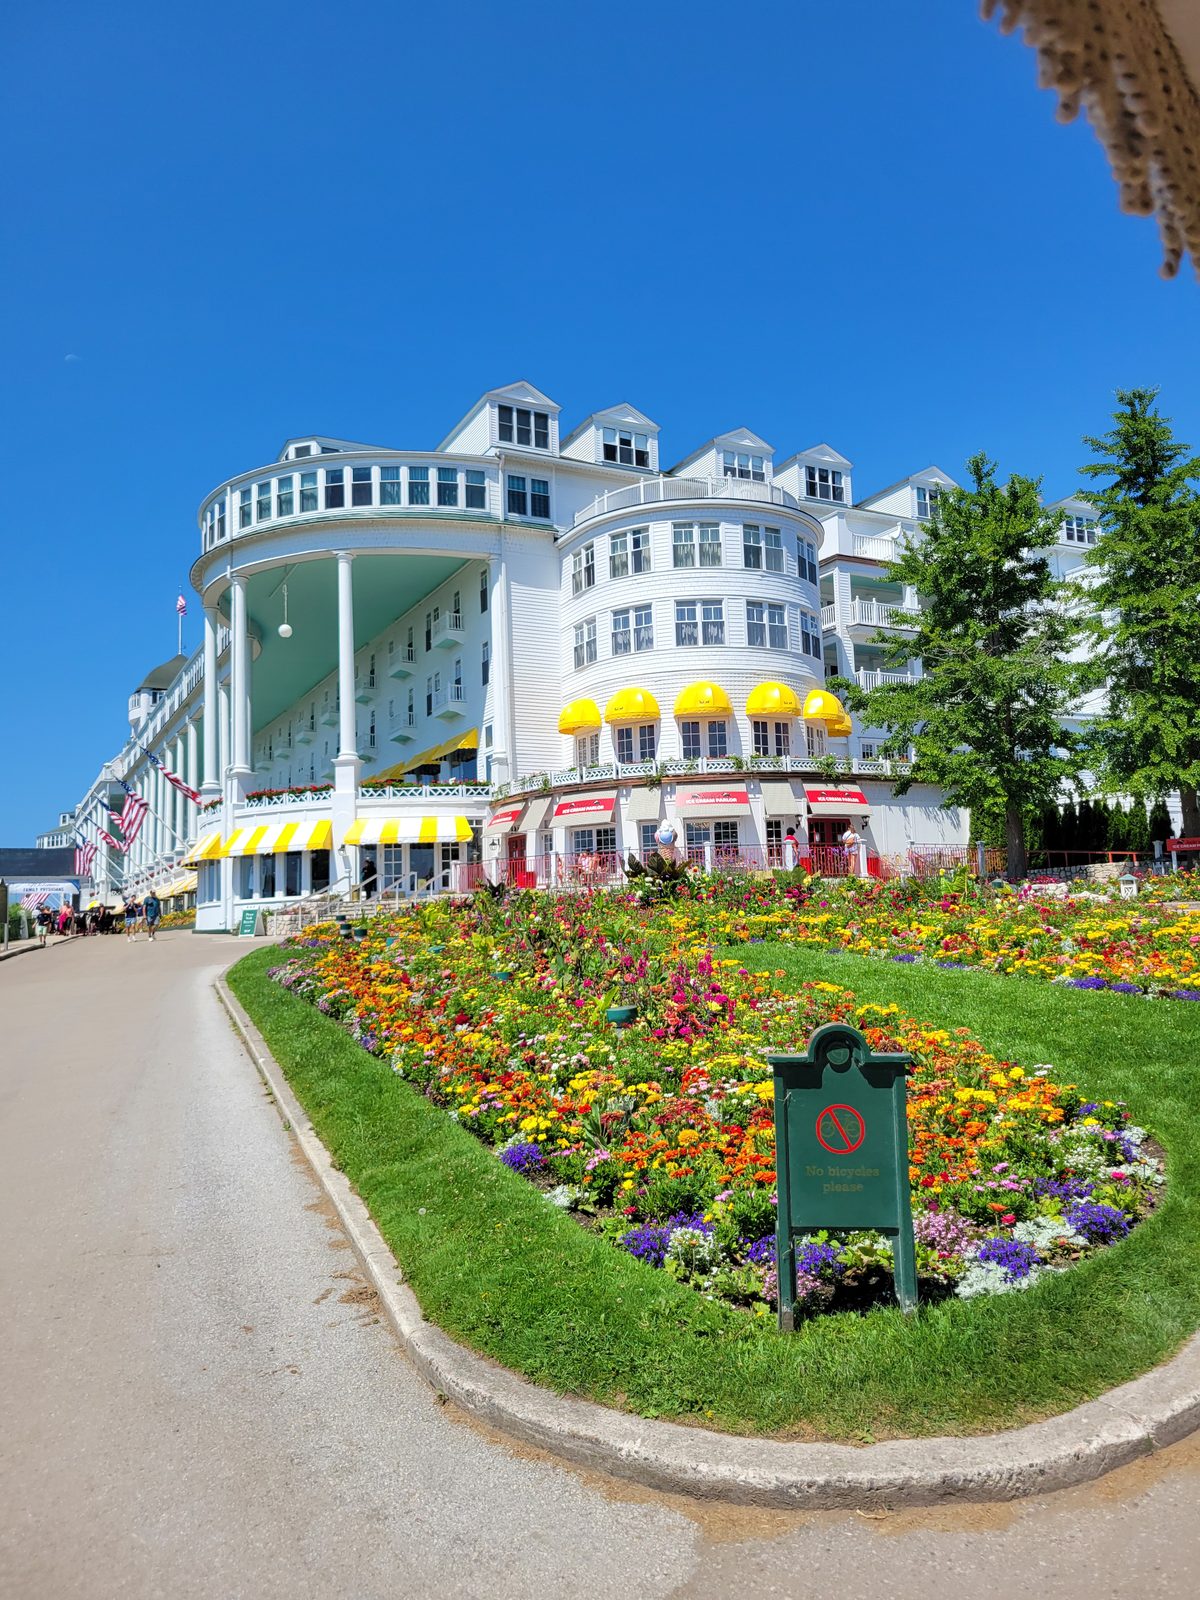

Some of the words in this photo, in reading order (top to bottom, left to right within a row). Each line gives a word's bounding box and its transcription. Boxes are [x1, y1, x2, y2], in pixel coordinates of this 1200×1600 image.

[805, 1165, 825, 1177] No
[827, 1165, 880, 1179] bicycles
[822, 1181, 864, 1194] please
